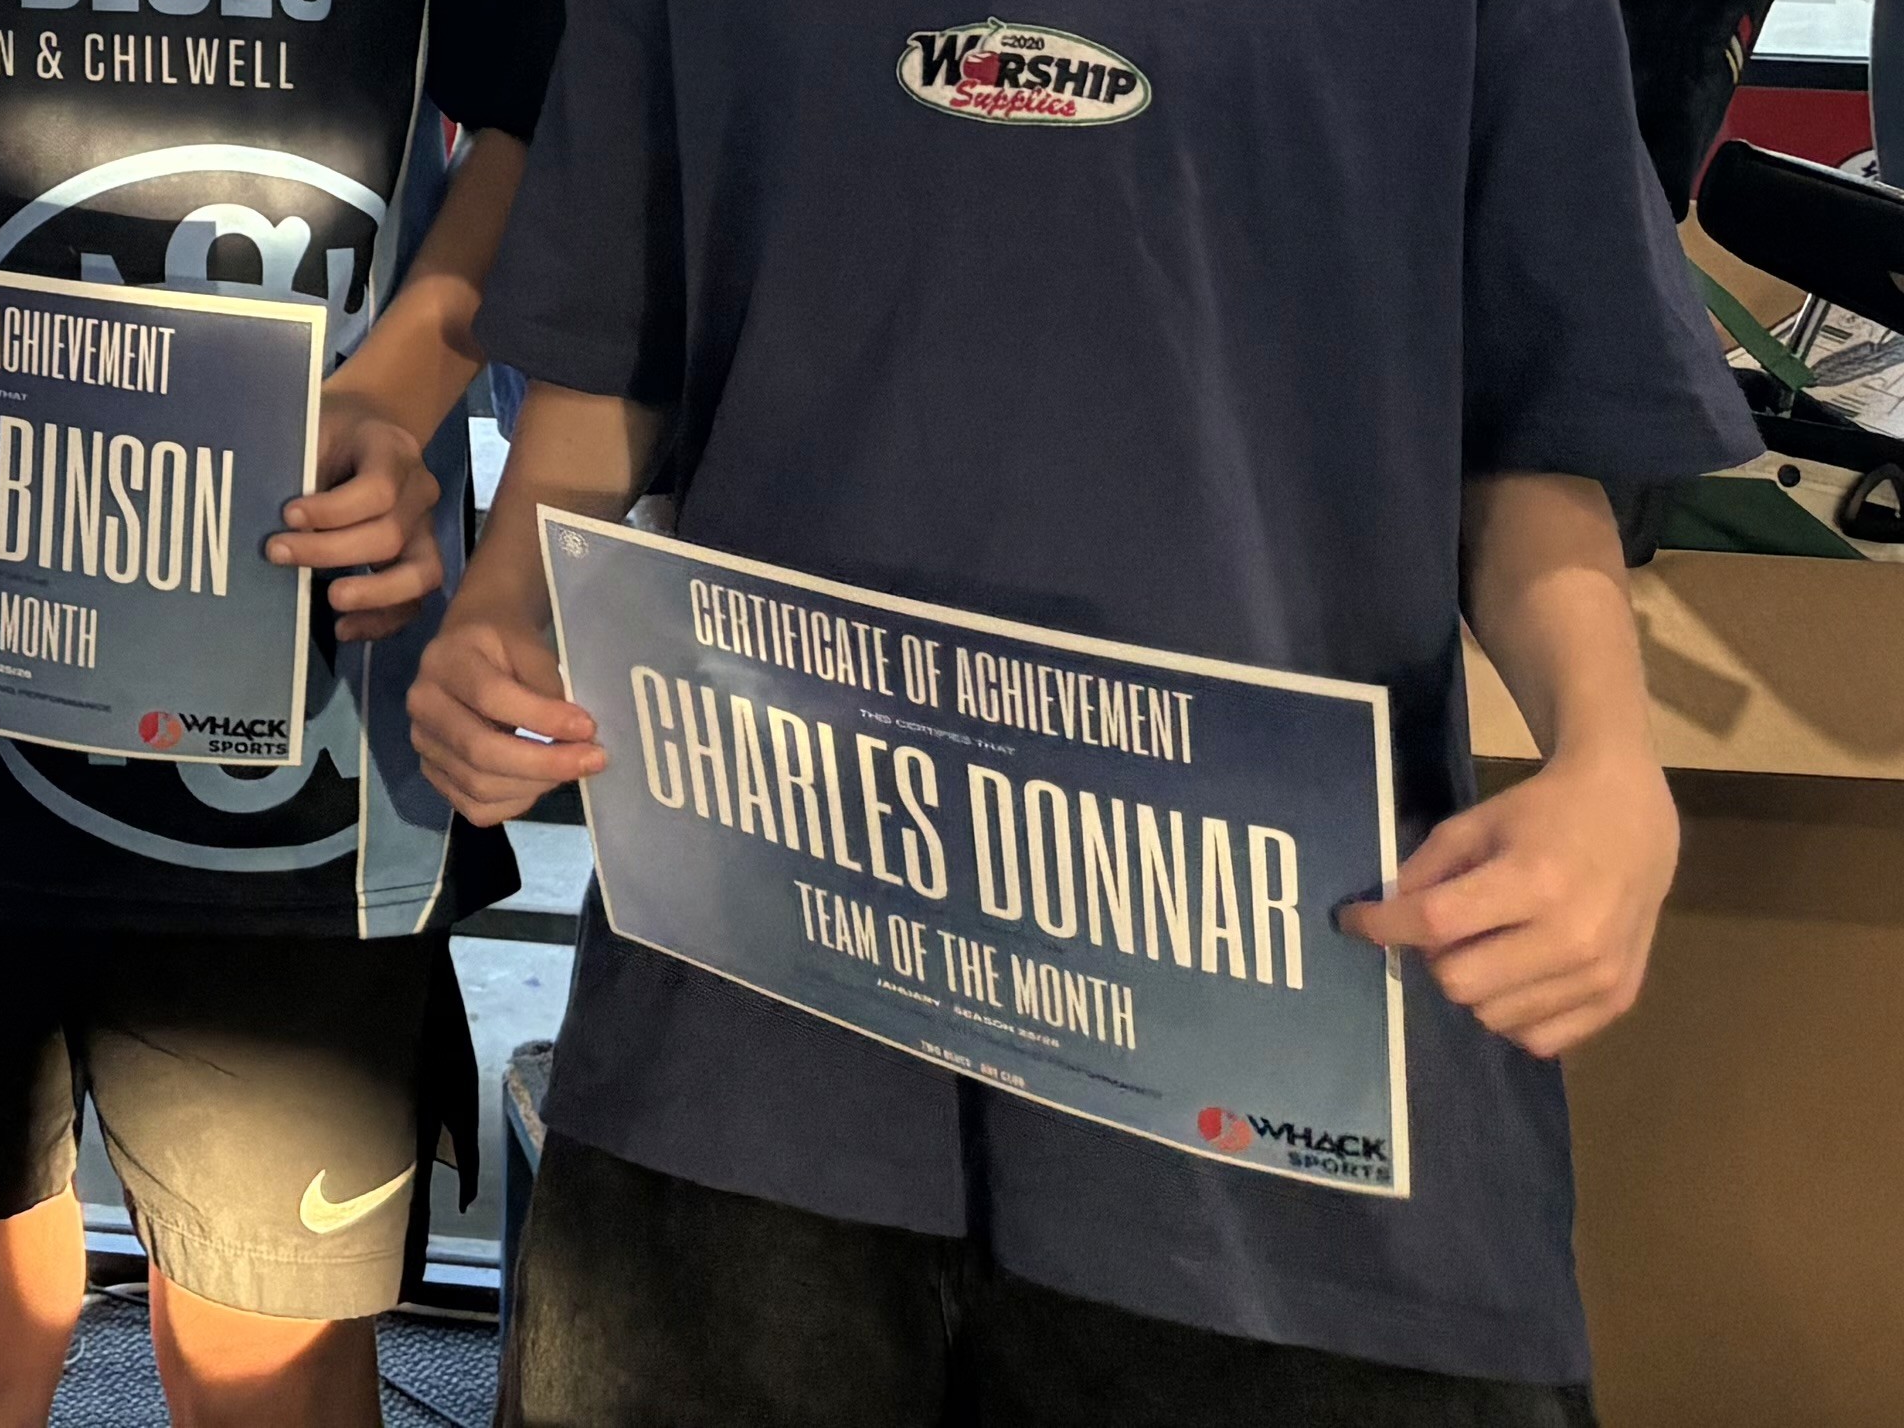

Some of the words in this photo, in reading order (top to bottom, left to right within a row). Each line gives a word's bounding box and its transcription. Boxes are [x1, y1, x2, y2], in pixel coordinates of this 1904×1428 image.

[36, 30, 64, 80] &
[84, 32, 294, 90] CHILWELL
[949, 79, 1078, 119] Supplies
[688, 576, 893, 699] CERTIFICATE
[901, 631, 943, 707] OF
[955, 645, 1194, 767] ACHIEVEMENT
[180, 711, 287, 739] WHACK
[208, 738, 289, 757] SPORTS
[628, 663, 949, 902] CHARLES
[966, 762, 1305, 992] DONNAR
[794, 880, 880, 968] TEAM
[888, 914, 930, 984] OF
[936, 929, 1002, 1008] THE
[1010, 952, 1137, 1053] MONTH
